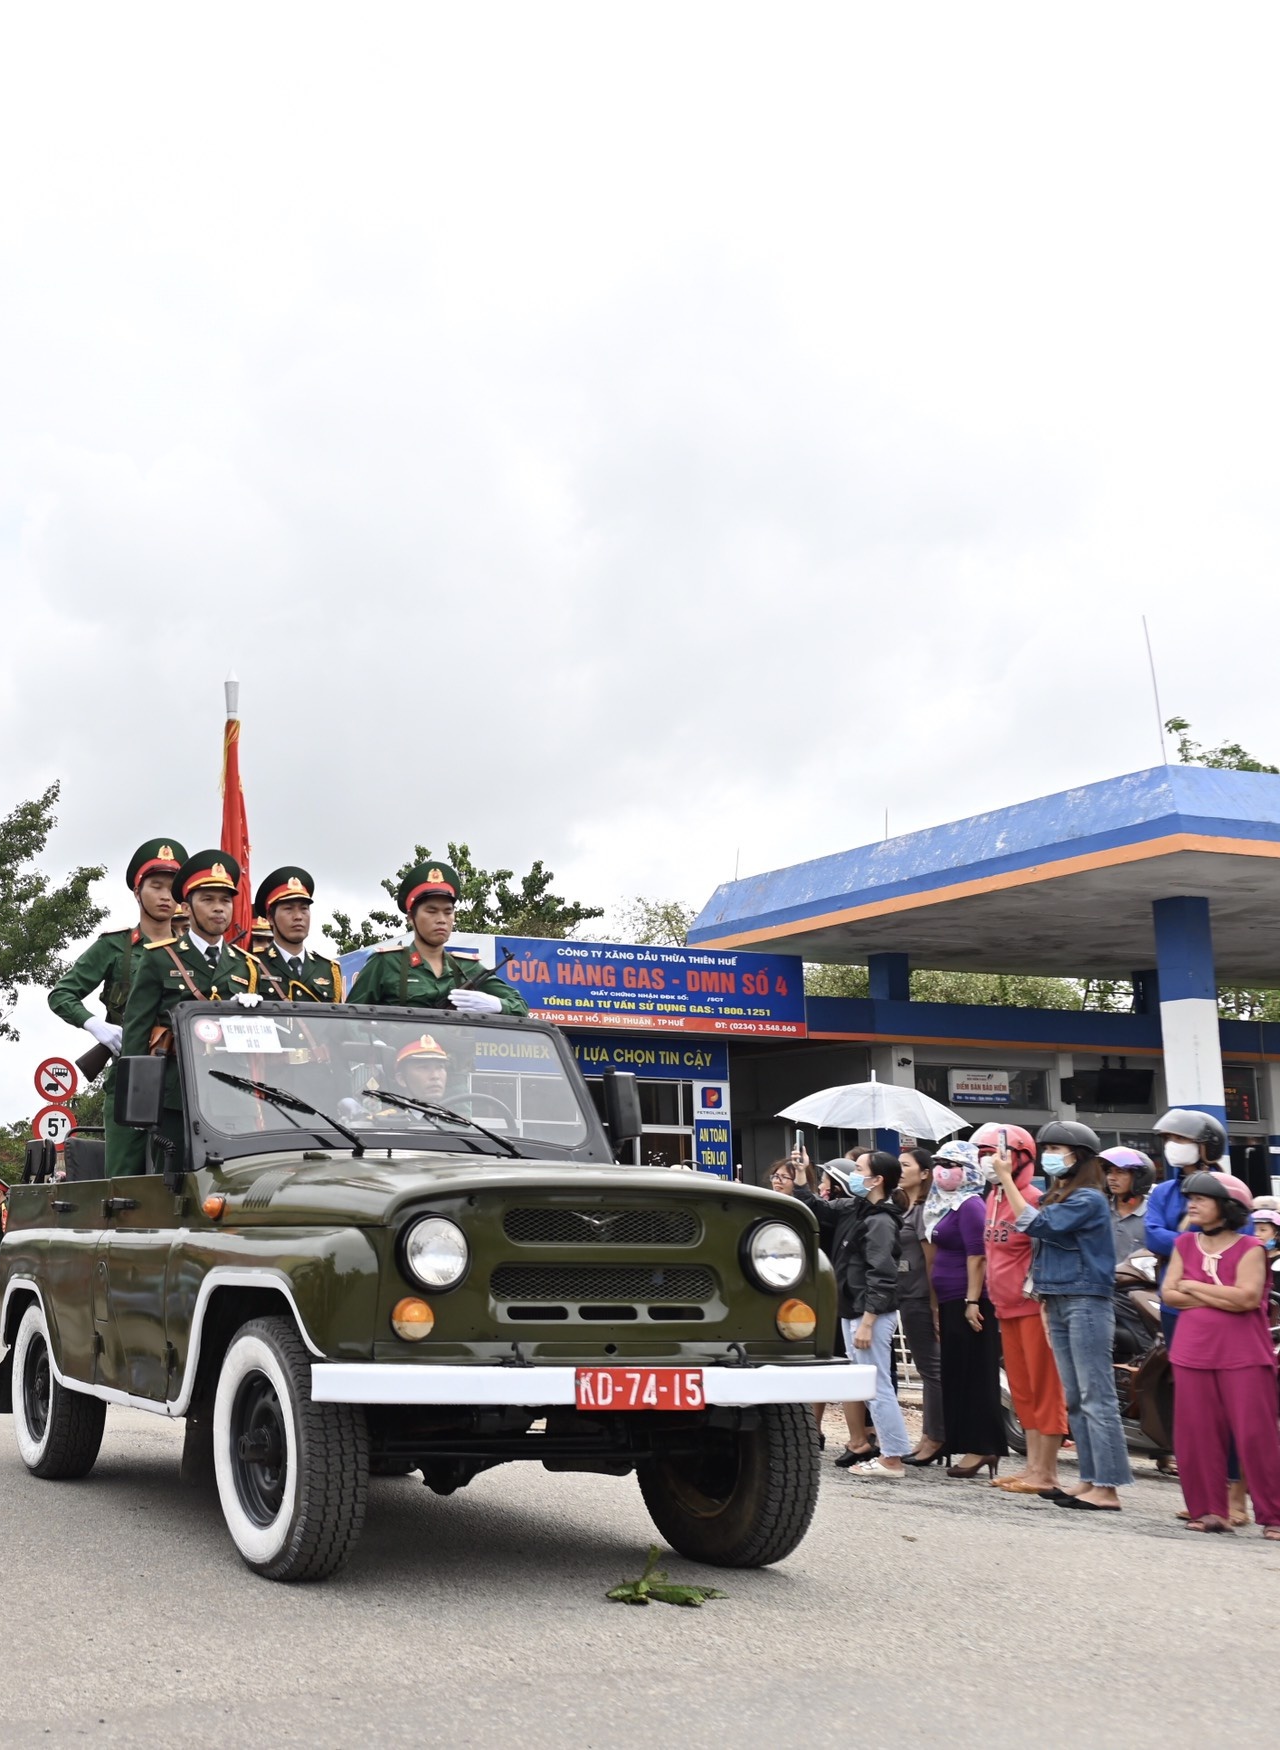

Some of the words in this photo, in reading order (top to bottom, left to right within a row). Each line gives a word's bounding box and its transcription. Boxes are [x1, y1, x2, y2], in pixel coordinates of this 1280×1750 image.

[556, 947, 589, 958] CÔNG
[591, 950, 602, 958] TY
[605, 950, 634, 960] XĂNG
[637, 950, 658, 961] DẦU
[660, 953, 687, 964] THỪA
[688, 955, 716, 965] THIÊN
[717, 956, 738, 966] HUẾ
[506, 951, 551, 984] CỬA
[557, 958, 616, 988] HÀNG
[622, 966, 666, 990] GAS
[686, 970, 736, 994] DMN
[741, 967, 769, 996] SỐ
[775, 975, 788, 996] 4
[542, 995, 573, 1007] TỔNG
[575, 997, 594, 1008] ĐÀI
[596, 999, 612, 1009] TƯ
[613, 999, 636, 1010] VẤN
[638, 1000, 655, 1011] SỬ
[656, 1003, 687, 1014] DỤNG
[689, 1005, 715, 1014] GAS:
[717, 1006, 771, 1017] 1800.1251
[541, 1012, 566, 1021] TĂNG
[567, 1014, 583, 1024] BẠT
[714, 1021, 727, 1029] ĐT:
[729, 1022, 757, 1032] (0234)
[758, 1023, 797, 1033] 3.548.868
[475, 1041, 551, 1060] ETROLIMEX
[584, 1042, 610, 1065] LỰA
[613, 1048, 655, 1067] CHỌN
[658, 1050, 680, 1065] TIN
[683, 1049, 713, 1070] CẬY
[699, 1127, 709, 1142] AN
[709, 1124, 728, 1143] TOÀN
[701, 1147, 716, 1169] TIỆN
[716, 1150, 727, 1170] LỢI
[580, 1372, 702, 1407] KD-74-15
